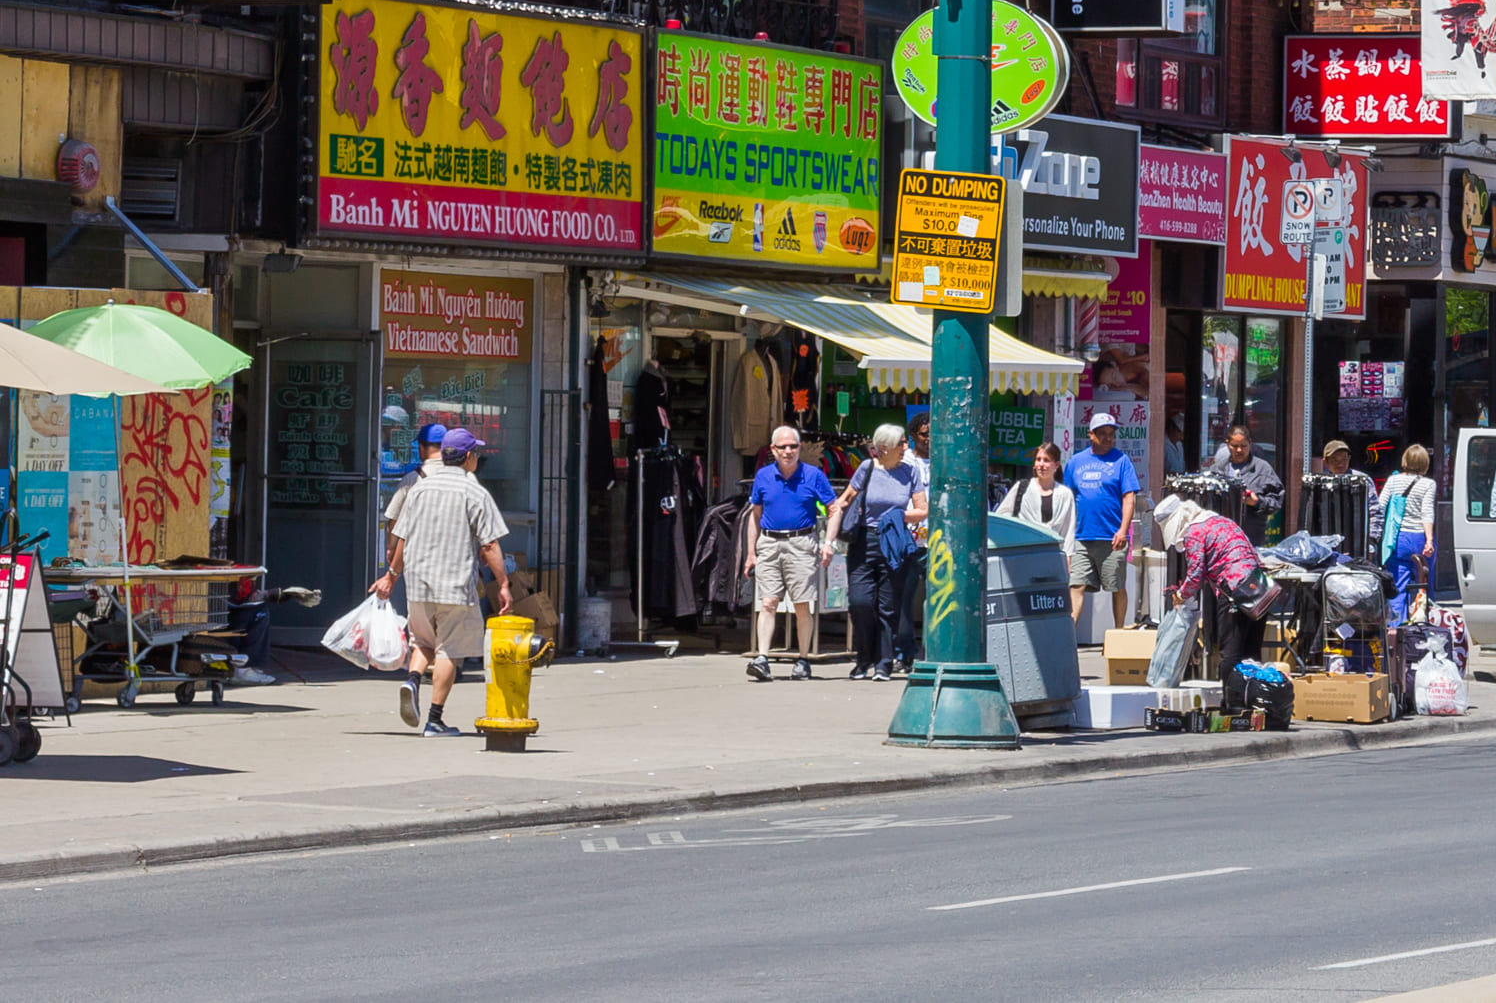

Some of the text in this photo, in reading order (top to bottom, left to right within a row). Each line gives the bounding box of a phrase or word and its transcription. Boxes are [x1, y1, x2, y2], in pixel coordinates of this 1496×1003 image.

[657, 43, 881, 142] 時尚運動鞋專門店
[336, 136, 377, 176] 馳名
[656, 132, 878, 198] TODAYS SPORTSWEAR
[1017, 128, 1101, 201] Zone
[905, 175, 999, 201] NO DUMPING
[699, 200, 744, 223] Reebok
[914, 207, 960, 219] Maximum
[1139, 188, 1224, 220] henZhen Health Beauty
[330, 192, 637, 244] Bánh NGUYEN HUONG FOOD CO. LTD.
[1021, 215, 1126, 242] ersonalize Your Phone
[1285, 222, 1311, 231] SNOW
[774, 236, 801, 252] adidas
[846, 228, 871, 254] Lugz
[900, 235, 993, 260] 不可棄置垃圾
[1283, 232, 1313, 242] ROUTE
[949, 278, 991, 291] $10,000
[1225, 272, 1306, 305] DUMPLING HOUSE
[383, 278, 482, 325] Bánh Nguyên
[386, 322, 519, 357] Vietnamese Sandwich
[277, 386, 353, 410] Café
[995, 427, 1026, 445] TEA
[1119, 426, 1147, 440] SALON
[1030, 594, 1055, 610] Litter
